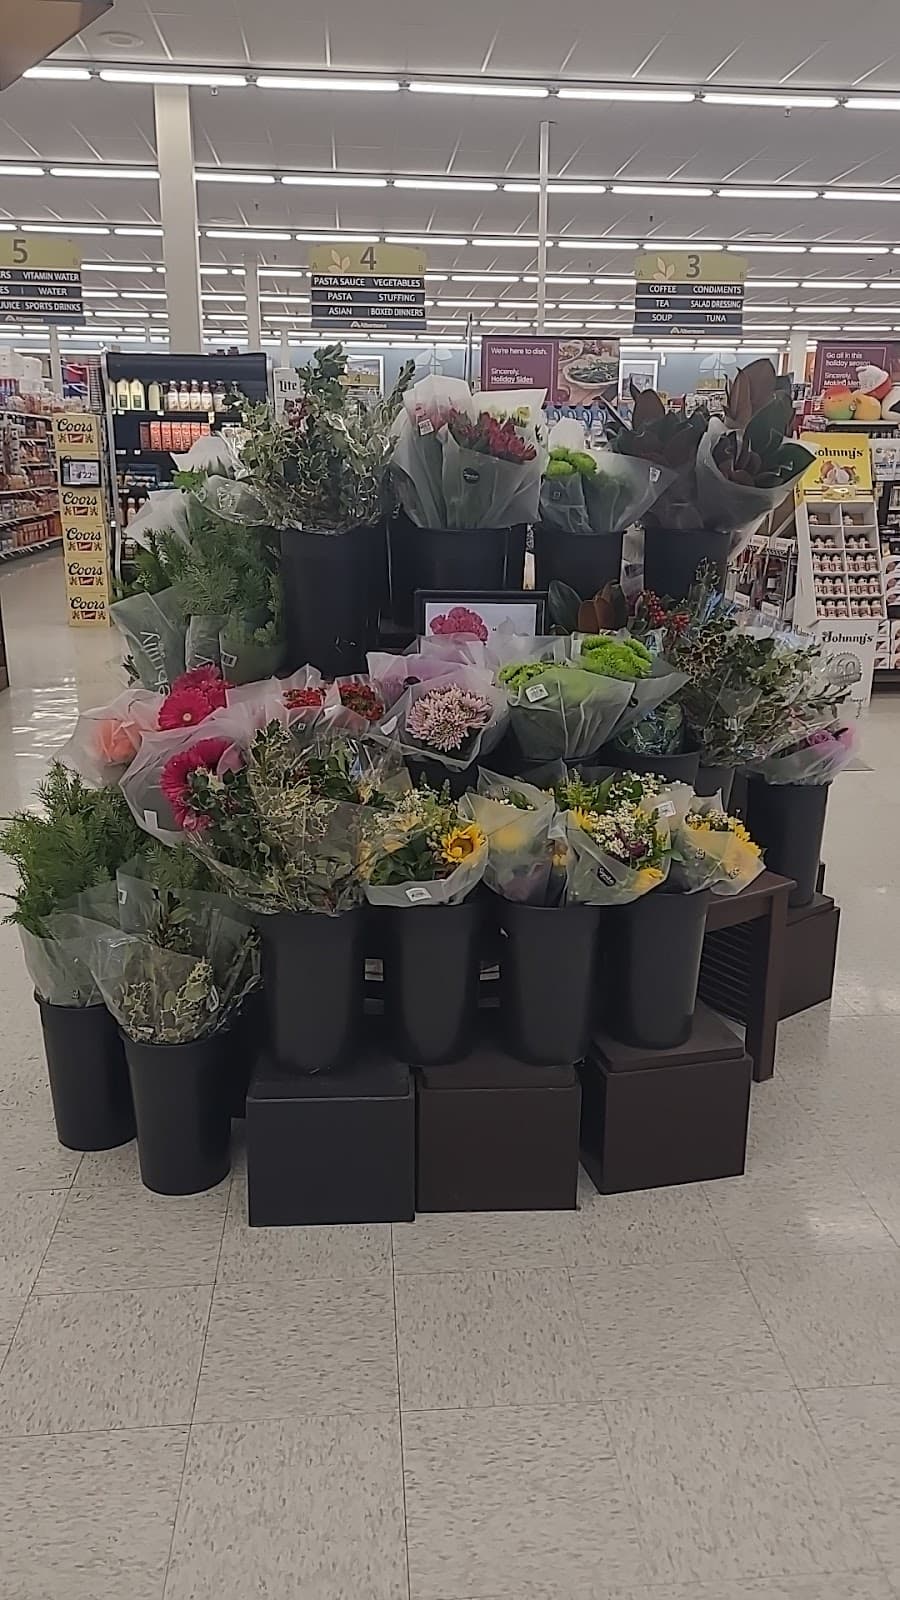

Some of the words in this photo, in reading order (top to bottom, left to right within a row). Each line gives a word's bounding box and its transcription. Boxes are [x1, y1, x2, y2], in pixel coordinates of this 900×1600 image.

[13, 239, 28, 264] 5
[360, 246, 377, 271] 4
[686, 254, 701, 279] 3
[23, 271, 53, 281] VITAMIN
[54, 273, 80, 281] WATER
[313, 277, 338, 286] PASTA
[340, 278, 366, 287] SAUCE
[373, 278, 421, 288] VEGETABLES
[38, 287, 68, 296] WATER
[649, 284, 678, 294] COFFEE
[693, 285, 742, 295] CONDIMENTS
[327, 292, 353, 301] PASTA
[378, 293, 416, 303] STUFFING
[0, 300, 21, 310] JUICE
[25, 301, 53, 311] SPORTS
[54, 302, 81, 312] DRINKS
[655, 299, 670, 308] TEA
[690, 300, 711, 308] SALAD
[711, 300, 741, 309] DRESSING
[328, 307, 353, 316] ASIAN
[370, 308, 394, 317] BOXED
[394, 308, 424, 317] DINNERS
[651, 313, 673, 323] SOUP
[705, 314, 727, 323] TUNA
[490, 347, 509, 355] We're
[509, 347, 524, 355] here
[826, 351, 836, 359] Go
[836, 351, 845, 359] all
[845, 351, 851, 359] in
[851, 351, 863, 359] this
[825, 360, 849, 368] holiday
[491, 375, 516, 385] Holiday
[516, 376, 533, 384] Sides
[279, 380, 297, 392] Lite
[56, 418, 93, 432] Coors
[814, 447, 864, 460] ohnny's
[61, 491, 98, 506] Coors
[66, 527, 102, 541] Coors
[68, 562, 103, 576] Coors
[70, 597, 105, 610] Coors
[821, 630, 874, 646] Johnny's
